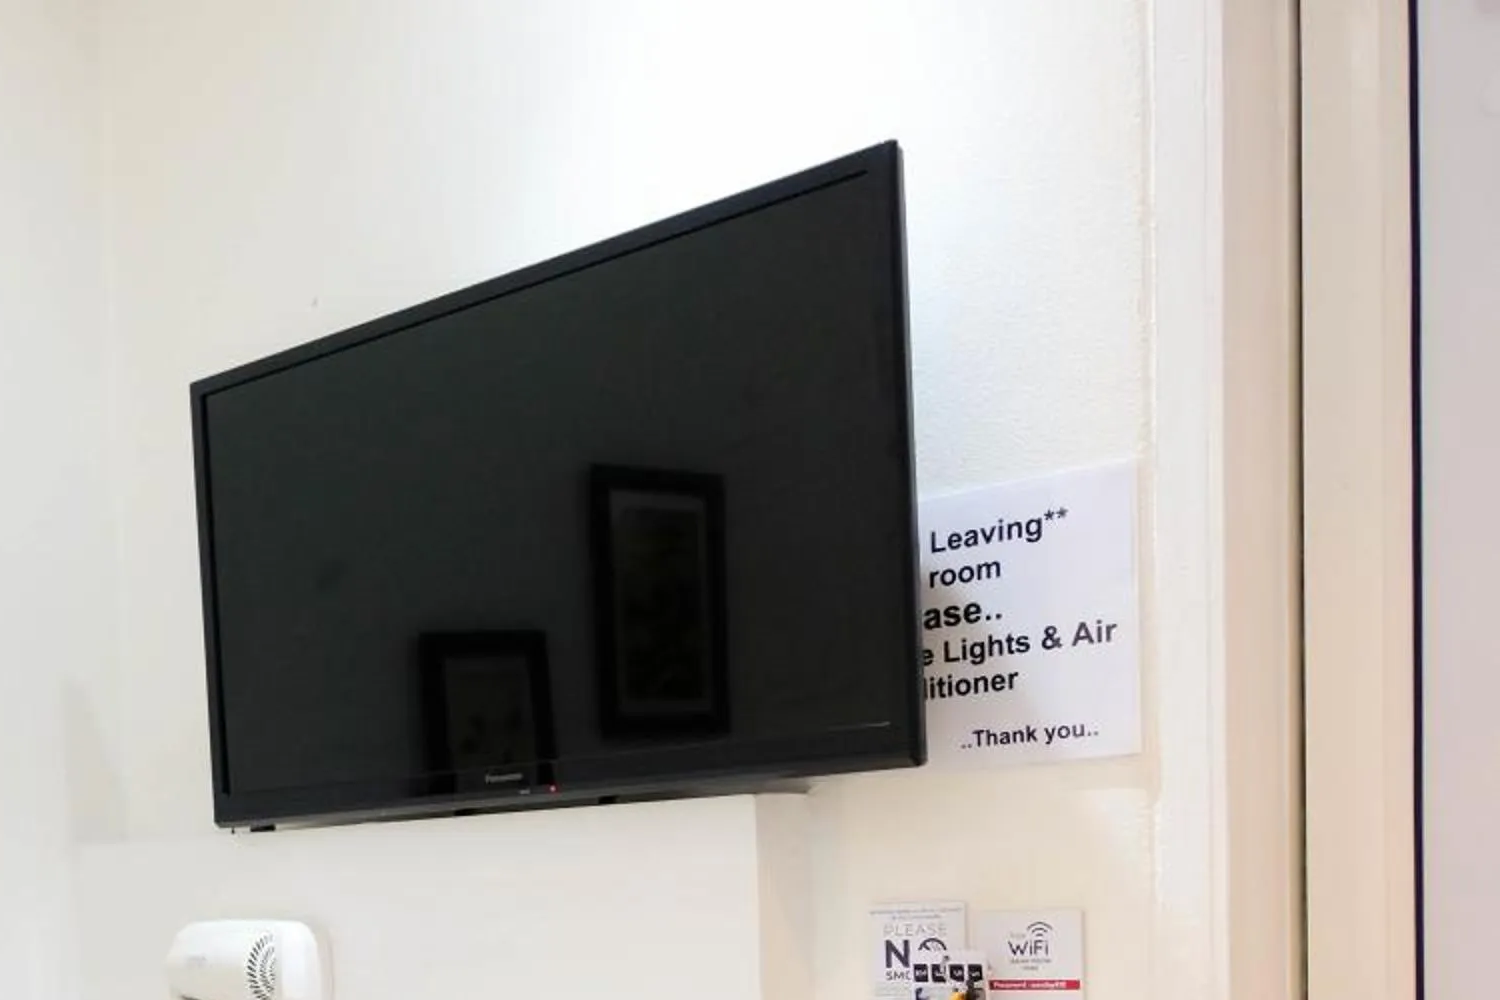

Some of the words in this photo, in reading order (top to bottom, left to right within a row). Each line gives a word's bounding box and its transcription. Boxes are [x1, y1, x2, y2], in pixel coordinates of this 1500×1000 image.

[929, 560, 1001, 588] room
[923, 602, 1002, 631] ase..
[943, 634, 1031, 665] Lights
[1041, 625, 1063, 651] &
[1072, 620, 1117, 647] Air
[924, 671, 1019, 700] itioner
[1044, 722, 1099, 745] you..
[883, 923, 947, 937] PLEASE
[1008, 940, 1049, 956] WiFi
